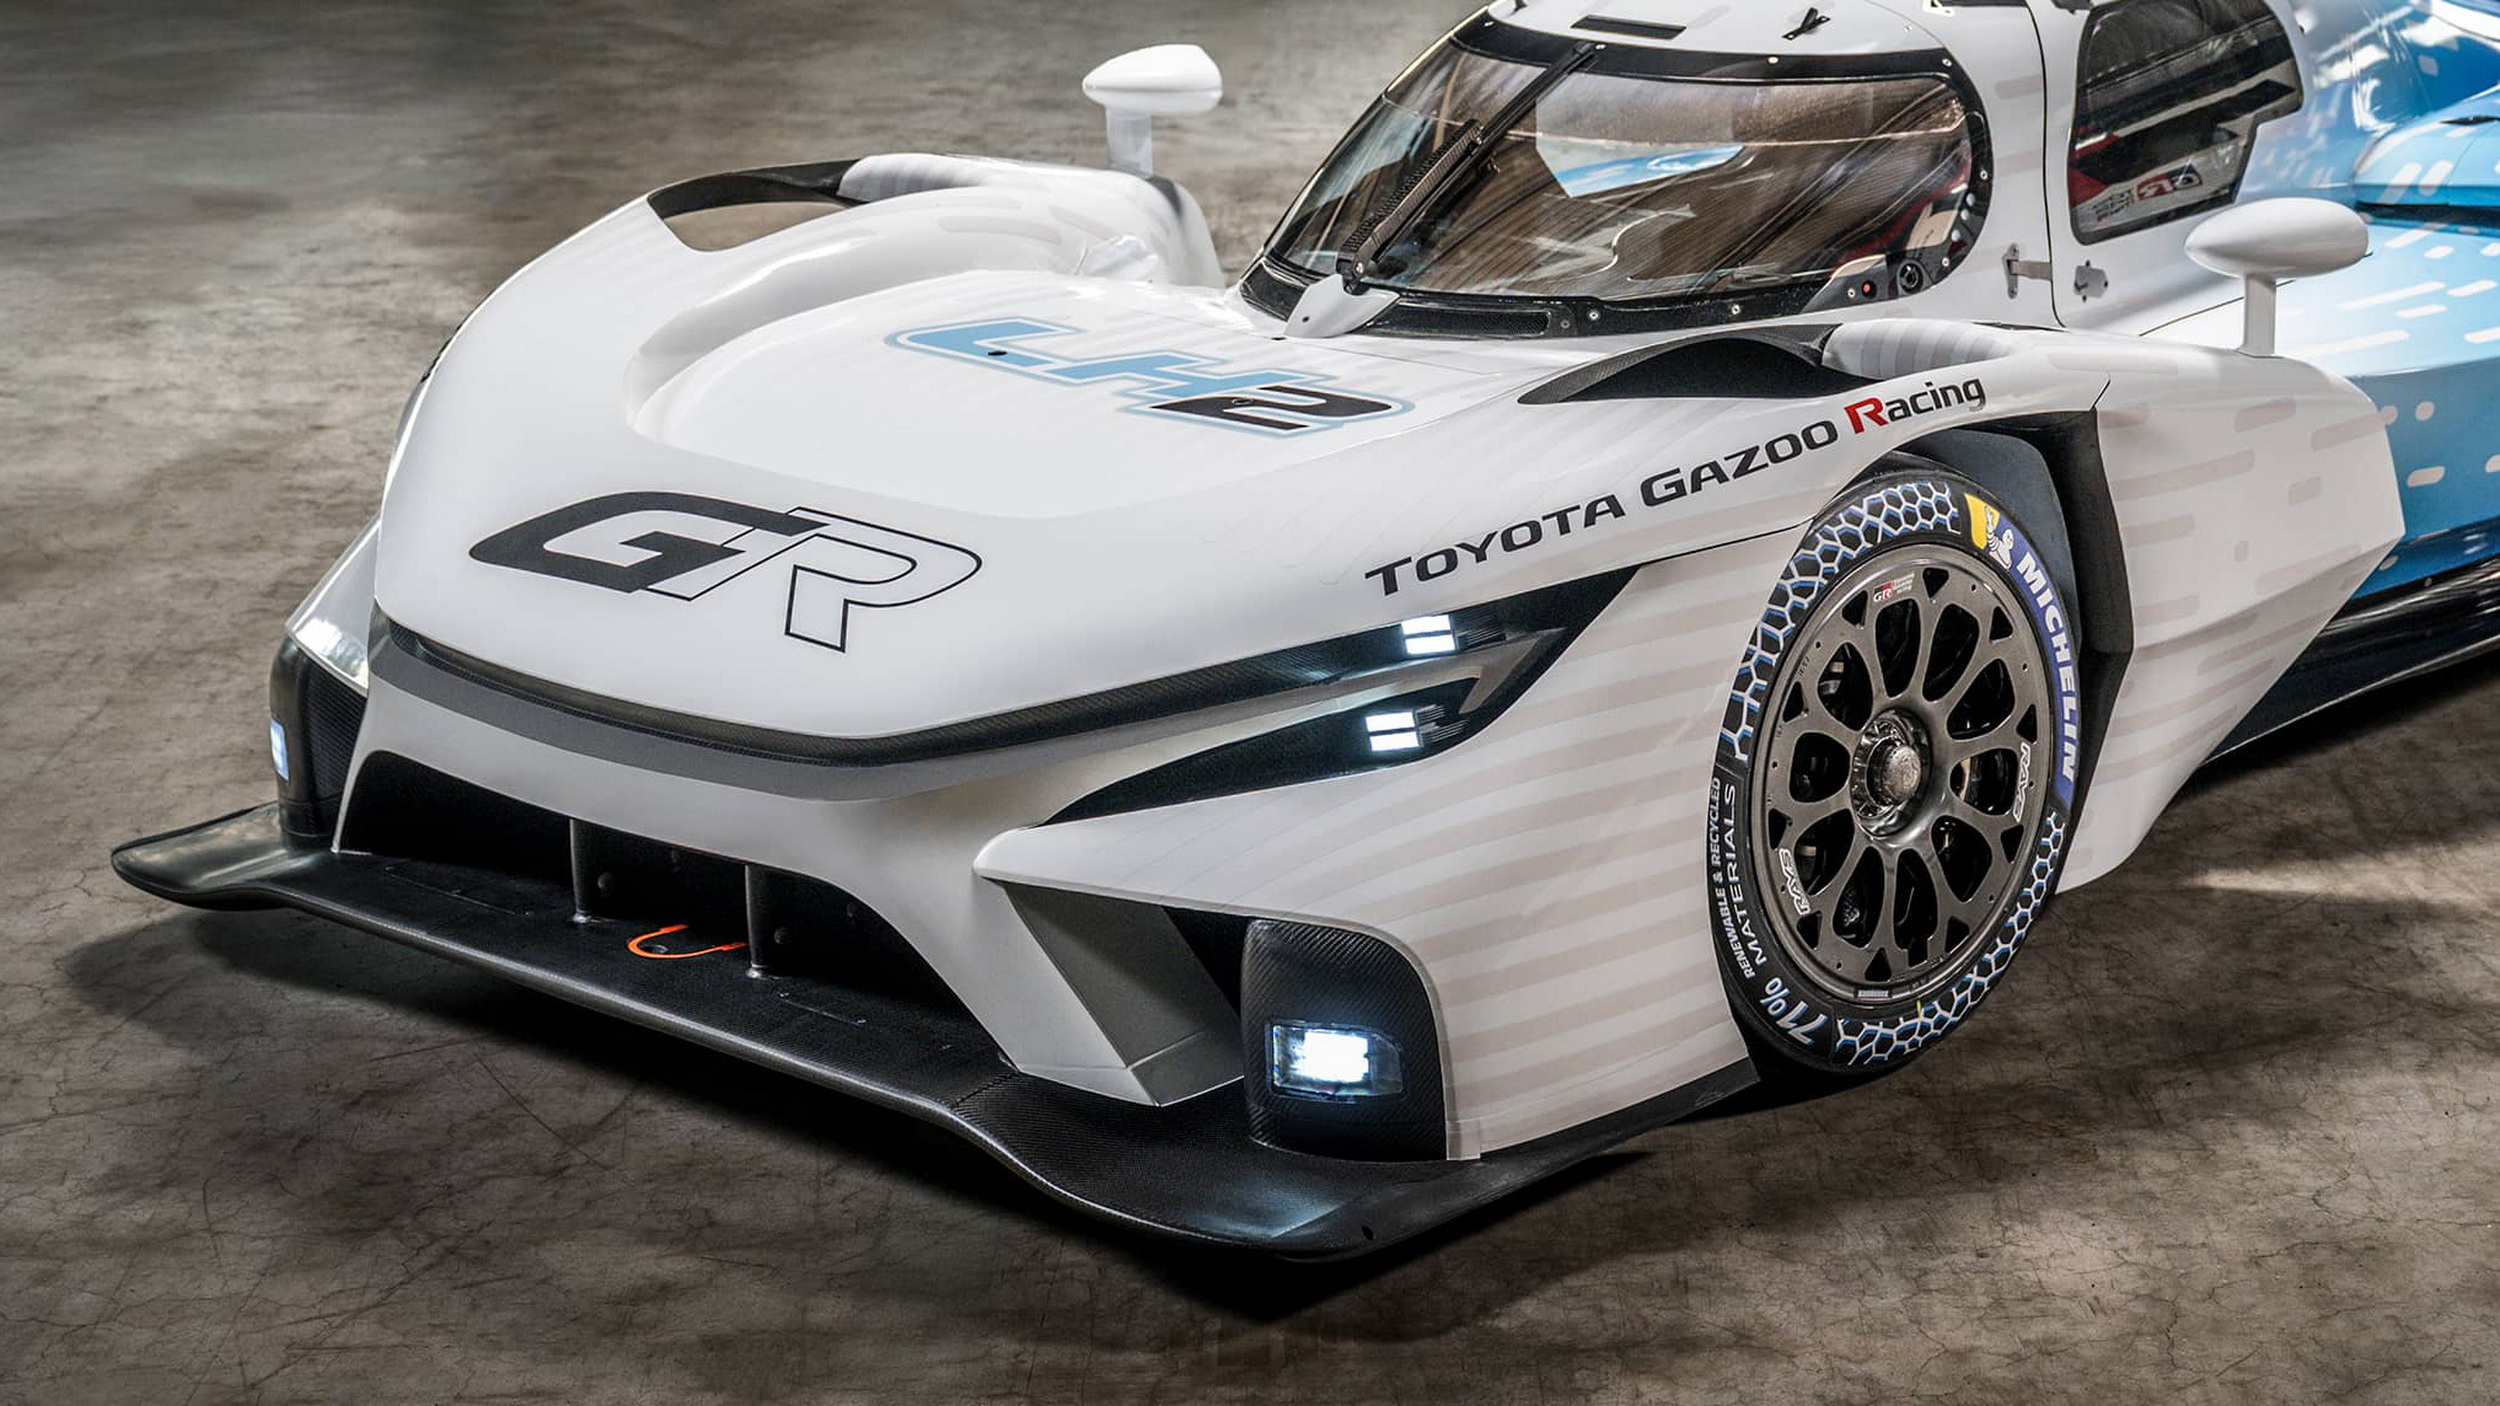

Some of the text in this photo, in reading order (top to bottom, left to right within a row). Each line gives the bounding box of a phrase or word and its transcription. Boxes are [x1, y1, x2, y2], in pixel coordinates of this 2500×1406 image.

[890, 317, 1411, 436] LH2
[1365, 377, 1986, 597] TOYOTA GAZOO Racing
[469, 491, 983, 652] GR
[2016, 552, 2078, 782] MICHELIN
[2013, 742, 2031, 822] RAYS
[1710, 777, 1755, 978] RENEWABLE & RECYCLED
[1724, 784, 1767, 965] MATERIALS
[1778, 848, 1811, 915] RAYS
[1760, 977, 1828, 1045] 71%
